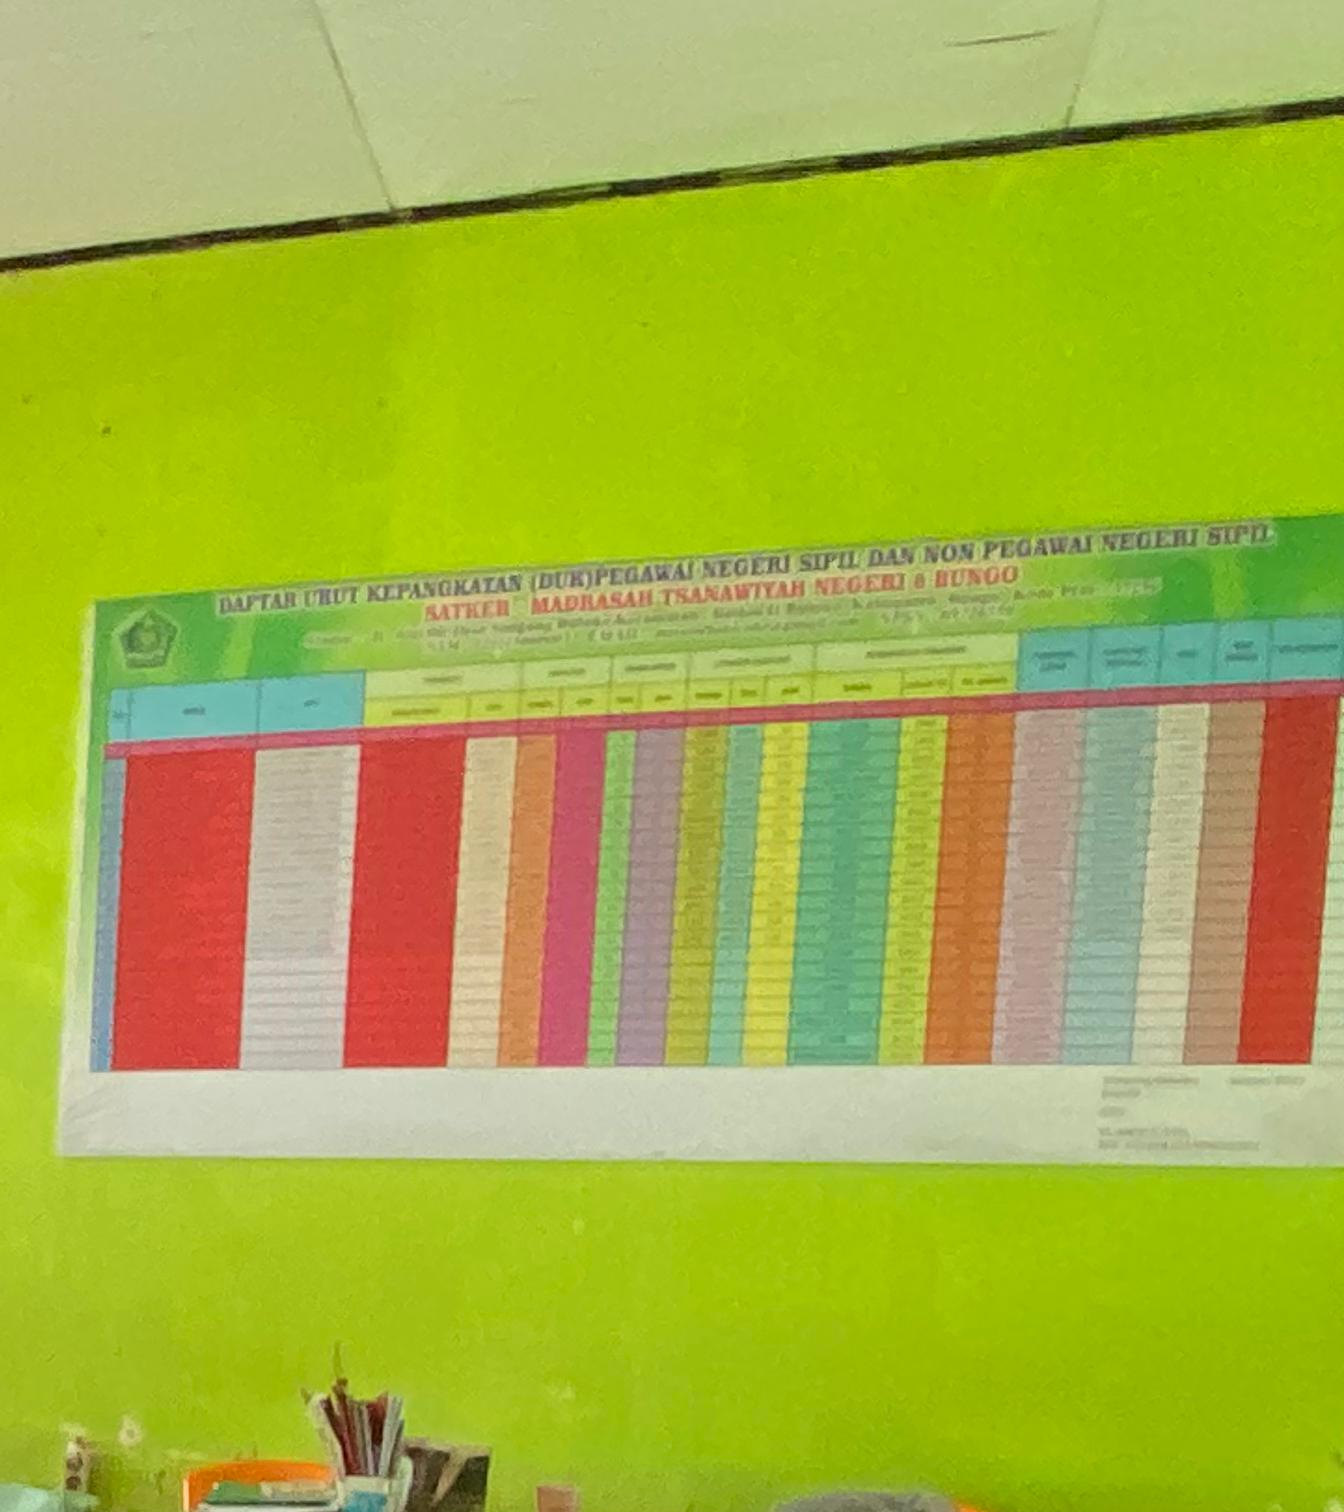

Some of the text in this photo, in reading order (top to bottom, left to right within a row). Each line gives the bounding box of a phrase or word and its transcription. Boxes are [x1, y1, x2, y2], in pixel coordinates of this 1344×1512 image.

[366, 573, 523, 603] KEPANGKATAN
[700, 554, 791, 579] NEGERI
[799, 550, 859, 573] SIPIL
[868, 547, 915, 567] DAN
[923, 544, 975, 563] NON
[982, 535, 1093, 560] PEGAWAI
[1101, 527, 1199, 551] NEGERI
[1206, 523, 1273, 546] SIPIL
[530, 588, 654, 616] MADRASAH
[660, 579, 806, 606] TSANAWIYAH
[814, 572, 907, 596] NEGERI
[934, 565, 1020, 589] BUNGO
